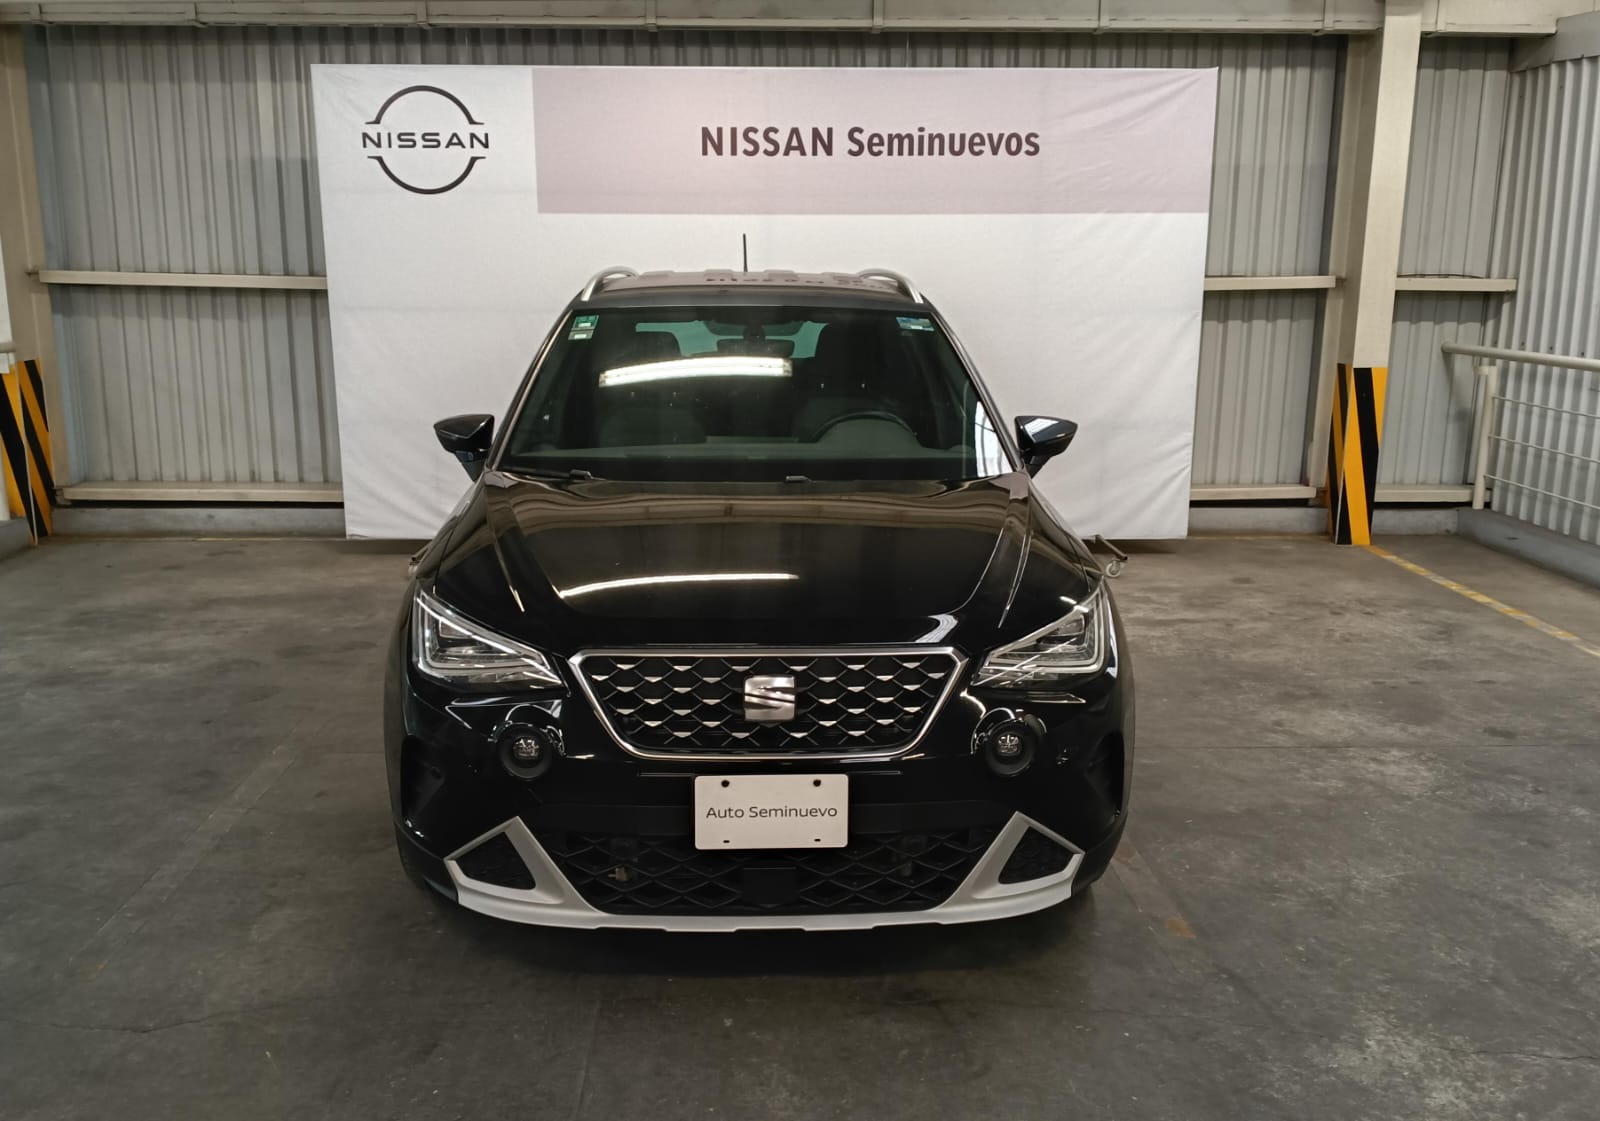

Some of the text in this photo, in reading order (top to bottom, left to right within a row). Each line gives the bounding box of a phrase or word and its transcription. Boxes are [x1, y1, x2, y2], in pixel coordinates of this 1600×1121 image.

[362, 132, 490, 149] NISSAN
[701, 126, 1040, 157] NISSAN Seminuevos
[706, 805, 838, 819] Auto Seminuevo
